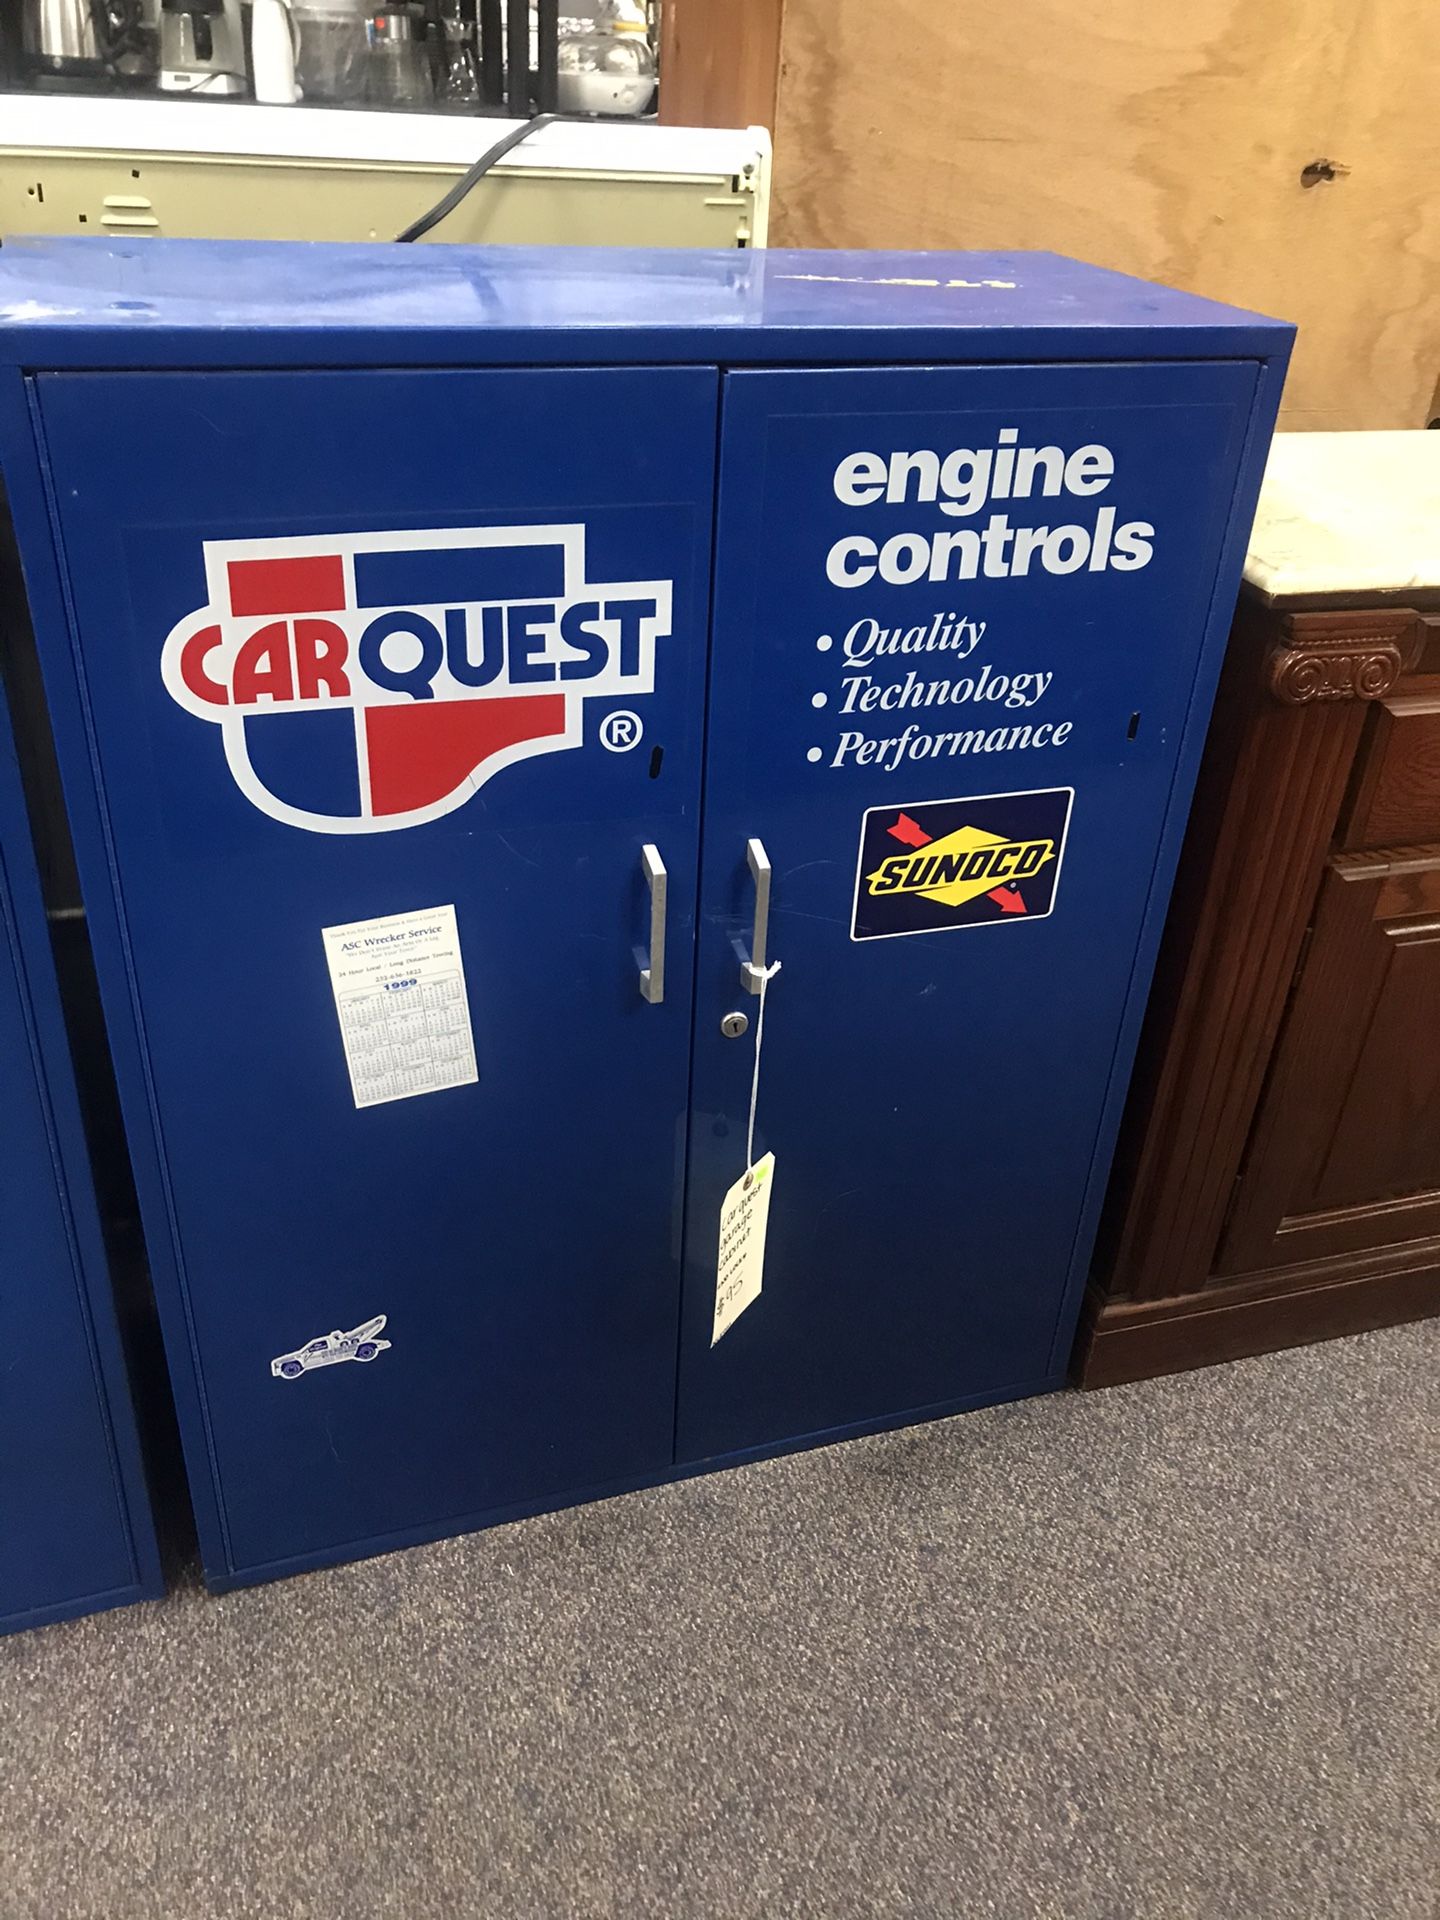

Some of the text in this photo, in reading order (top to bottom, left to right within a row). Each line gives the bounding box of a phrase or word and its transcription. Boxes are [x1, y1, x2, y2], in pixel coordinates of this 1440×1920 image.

[833, 428, 1115, 517] engine
[826, 506, 1155, 588] controls
[180, 599, 657, 706] CARQUEST
[842, 612, 987, 667] Quality
[838, 665, 1053, 714] Technology
[829, 720, 1073, 771] Performance
[874, 843, 1049, 888] SUNOCO
[341, 940, 361, 951] ASC
[364, 932, 406, 946] Wrecker
[408, 925, 442, 938] Service
[384, 978, 418, 991] 1999
